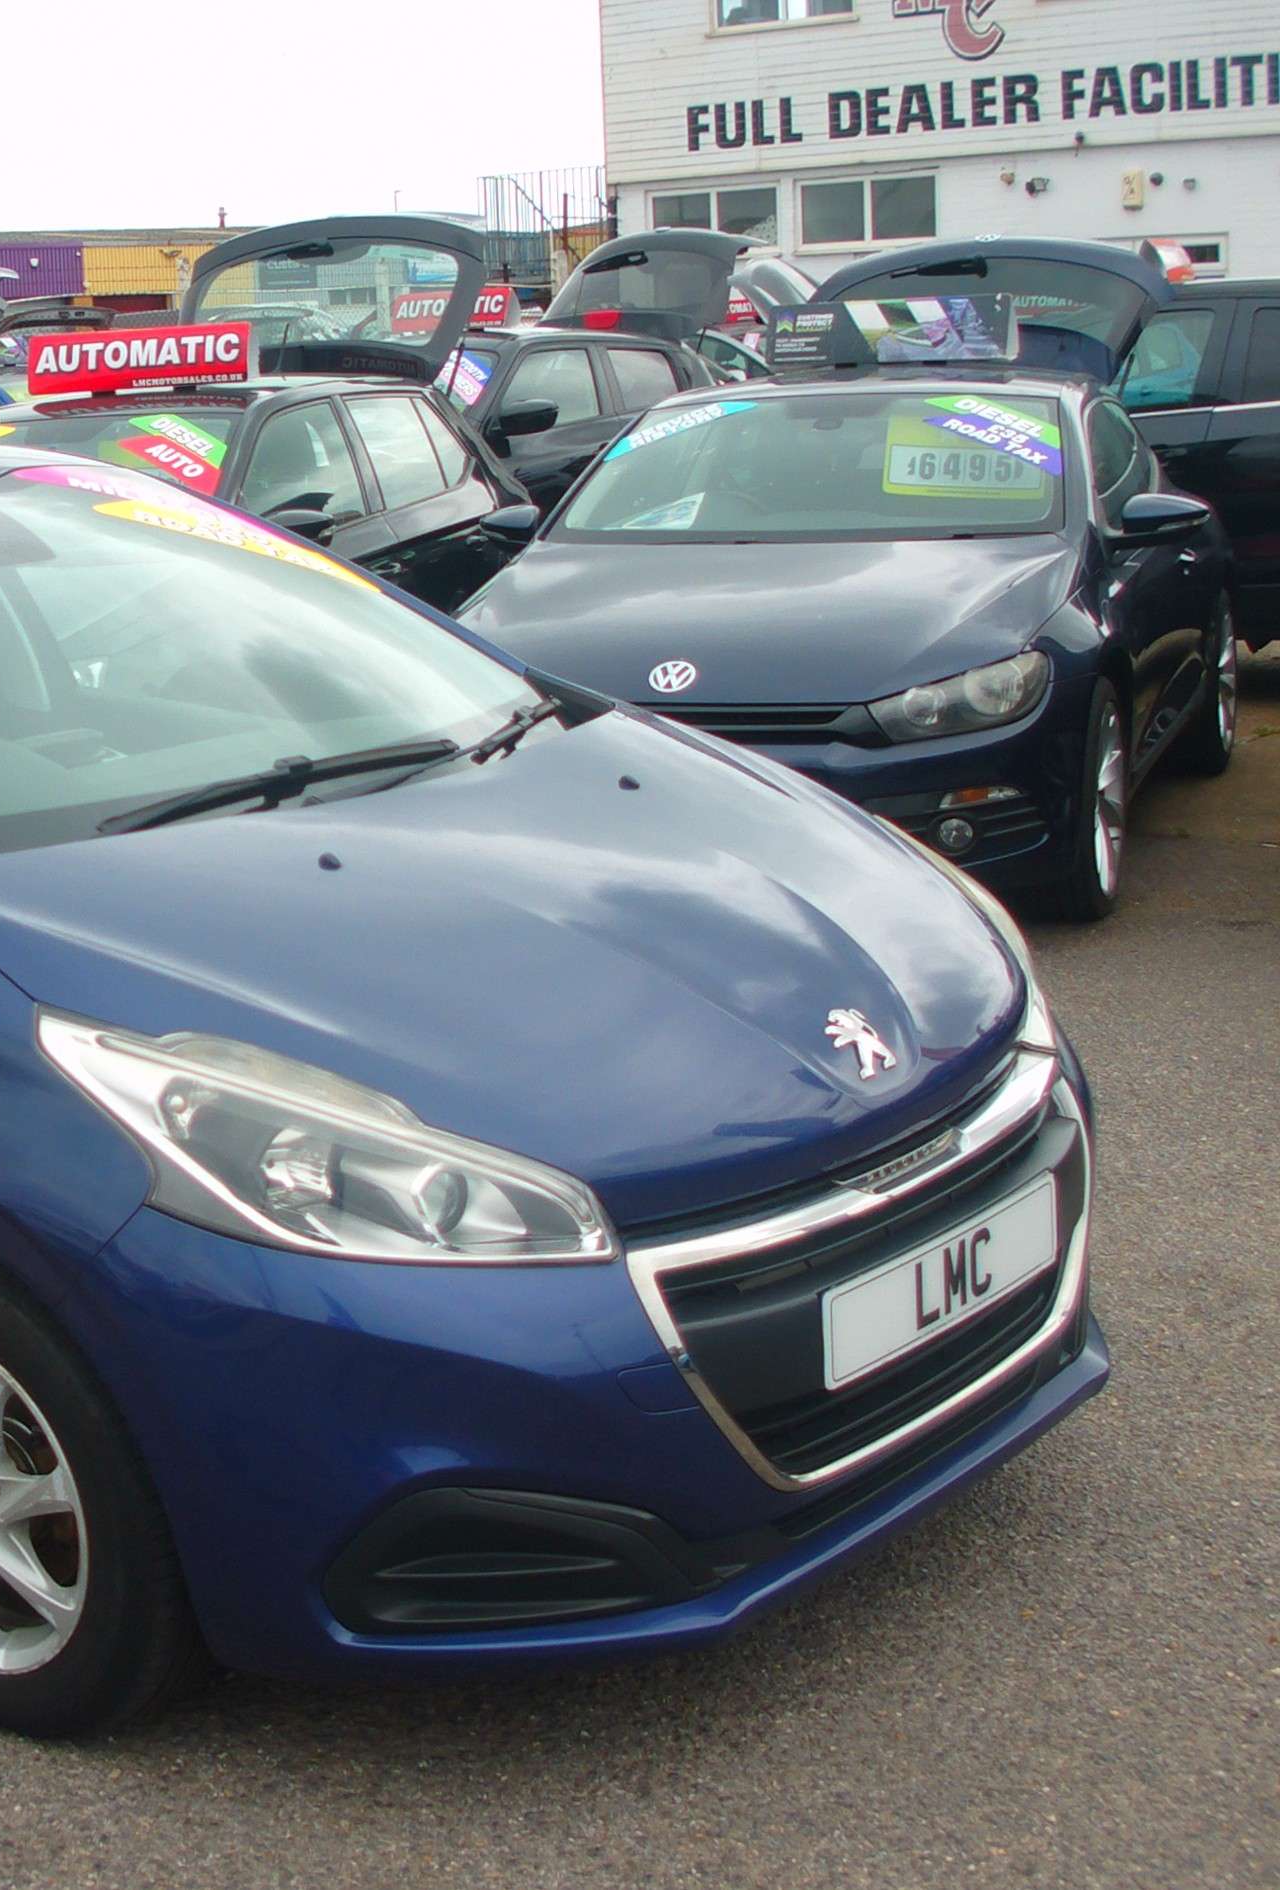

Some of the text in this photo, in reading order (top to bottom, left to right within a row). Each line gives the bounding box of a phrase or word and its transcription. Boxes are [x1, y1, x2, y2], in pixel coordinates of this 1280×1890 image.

[686, 52, 1280, 152] FULL DEALER FACILITI
[34, 333, 240, 375] AUTOMATIC
[132, 373, 243, 387] LMCMOTORSALES.CO.UK
[148, 415, 214, 456] DIESEL
[953, 398, 1044, 438] DIESEL
[144, 443, 204, 478] AUTO
[942, 418, 1049, 465] ROAD TAX
[915, 1227, 993, 1332] LMC
